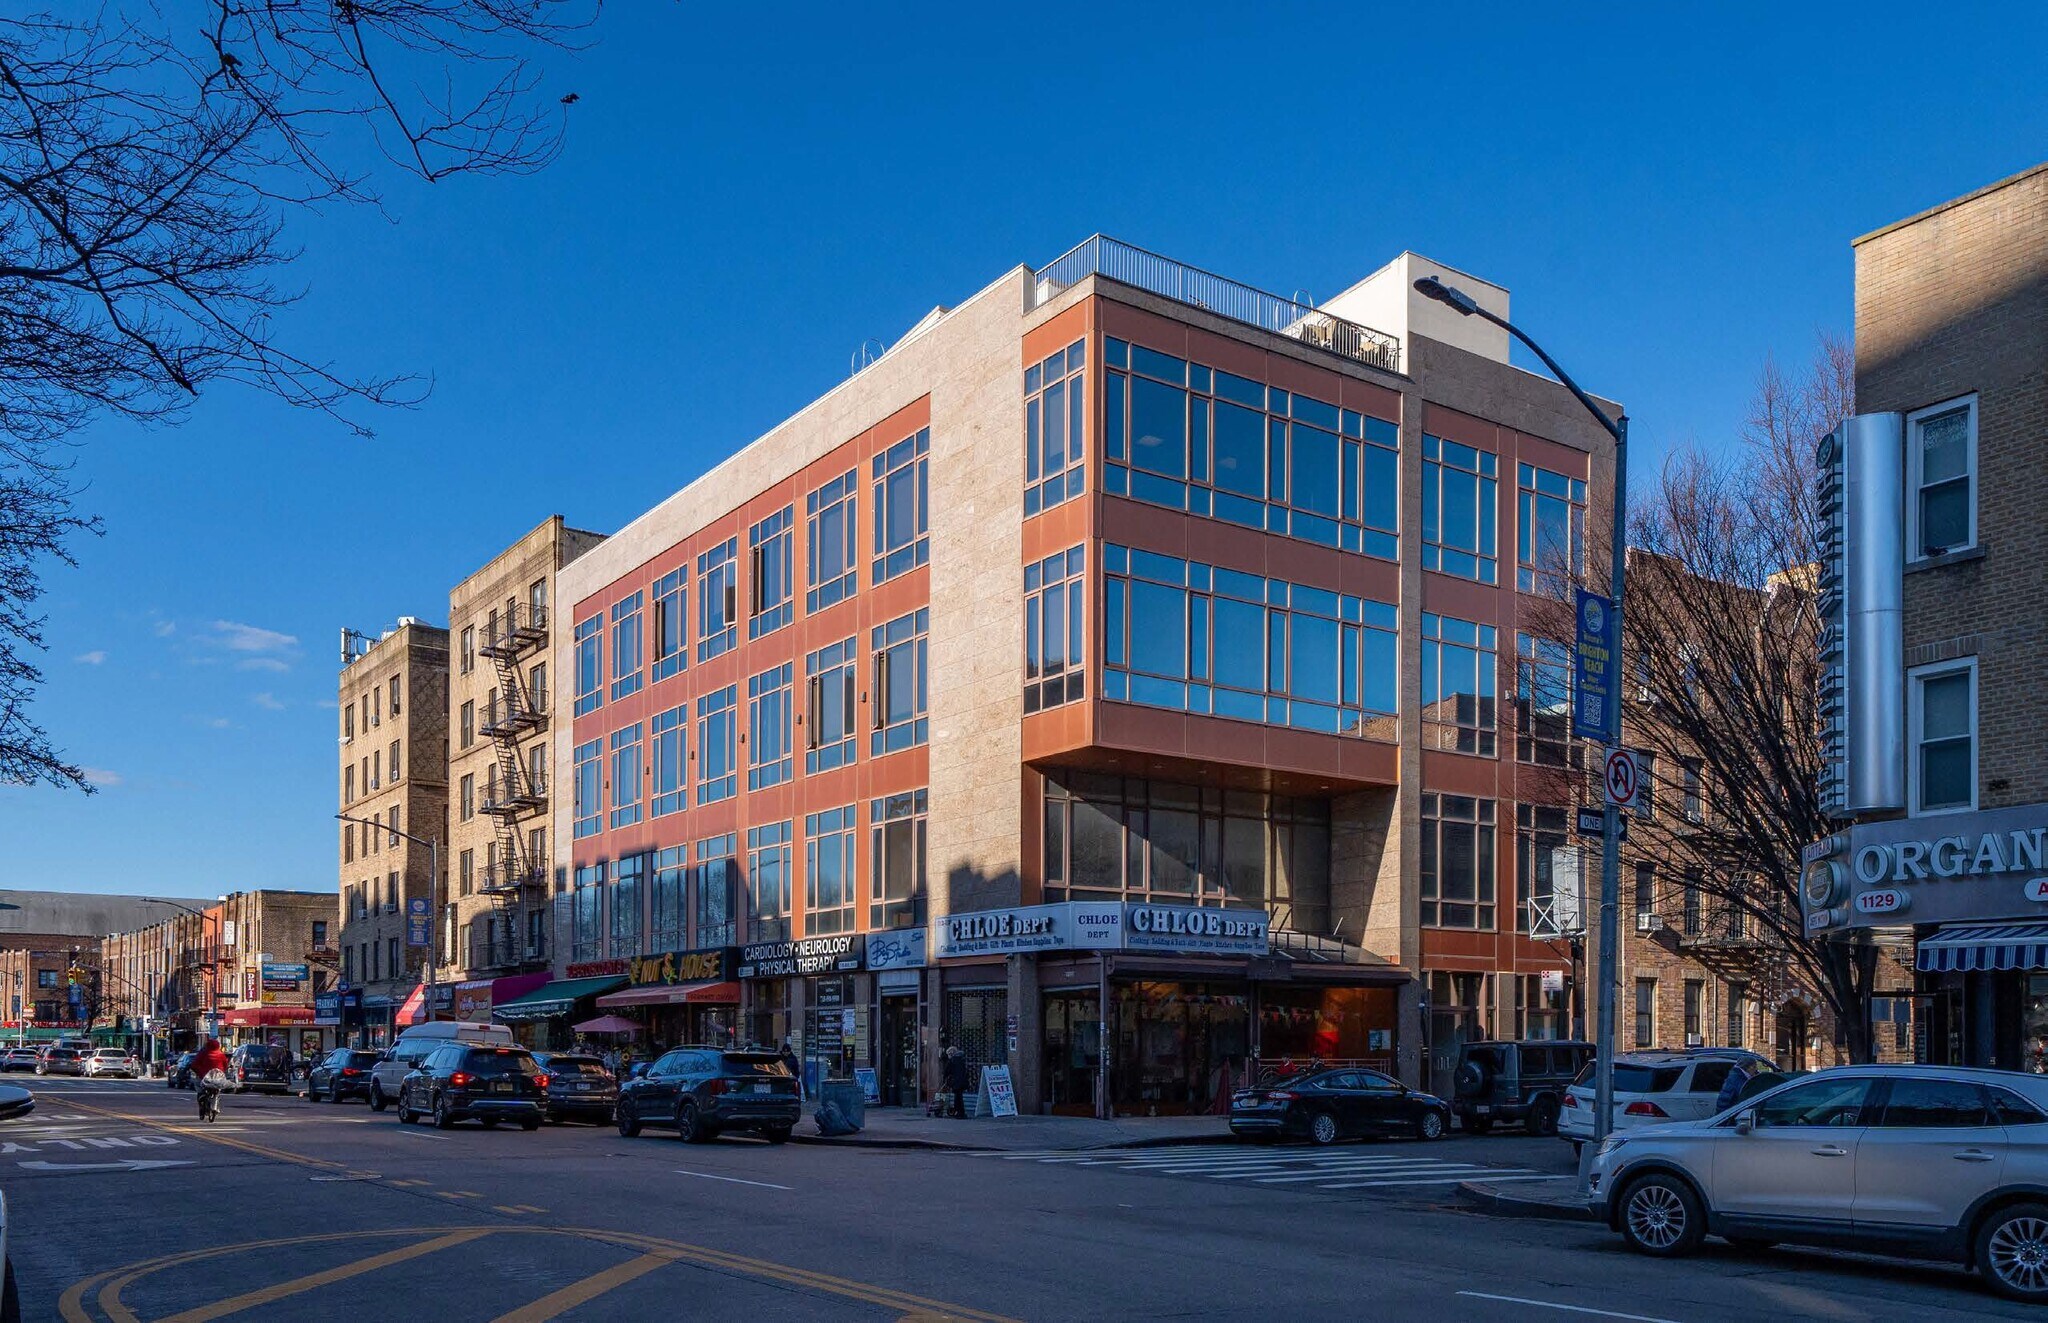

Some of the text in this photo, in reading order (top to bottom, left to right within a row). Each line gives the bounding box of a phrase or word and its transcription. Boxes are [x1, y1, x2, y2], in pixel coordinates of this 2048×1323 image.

[1579, 642, 1609, 661] BRIGHTON
[1584, 816, 1600, 829] ONE
[1854, 827, 2047, 884] ORGAN
[1861, 894, 1895, 908] 1129
[951, 914, 1049, 940] CHLOE DEPT
[1078, 914, 1118, 925] CHLOE
[1133, 908, 1266, 938] CHLOE DEPT
[1087, 930, 1109, 938] DEPT
[745, 937, 852, 962] CARDIOLOGY NEUROLOGY
[640, 952, 721, 983] NUT HOUSE
[759, 960, 796, 976] PHYSICAL
[797, 956, 835, 973] THERAPY
[247, 973, 256, 999] DELI
